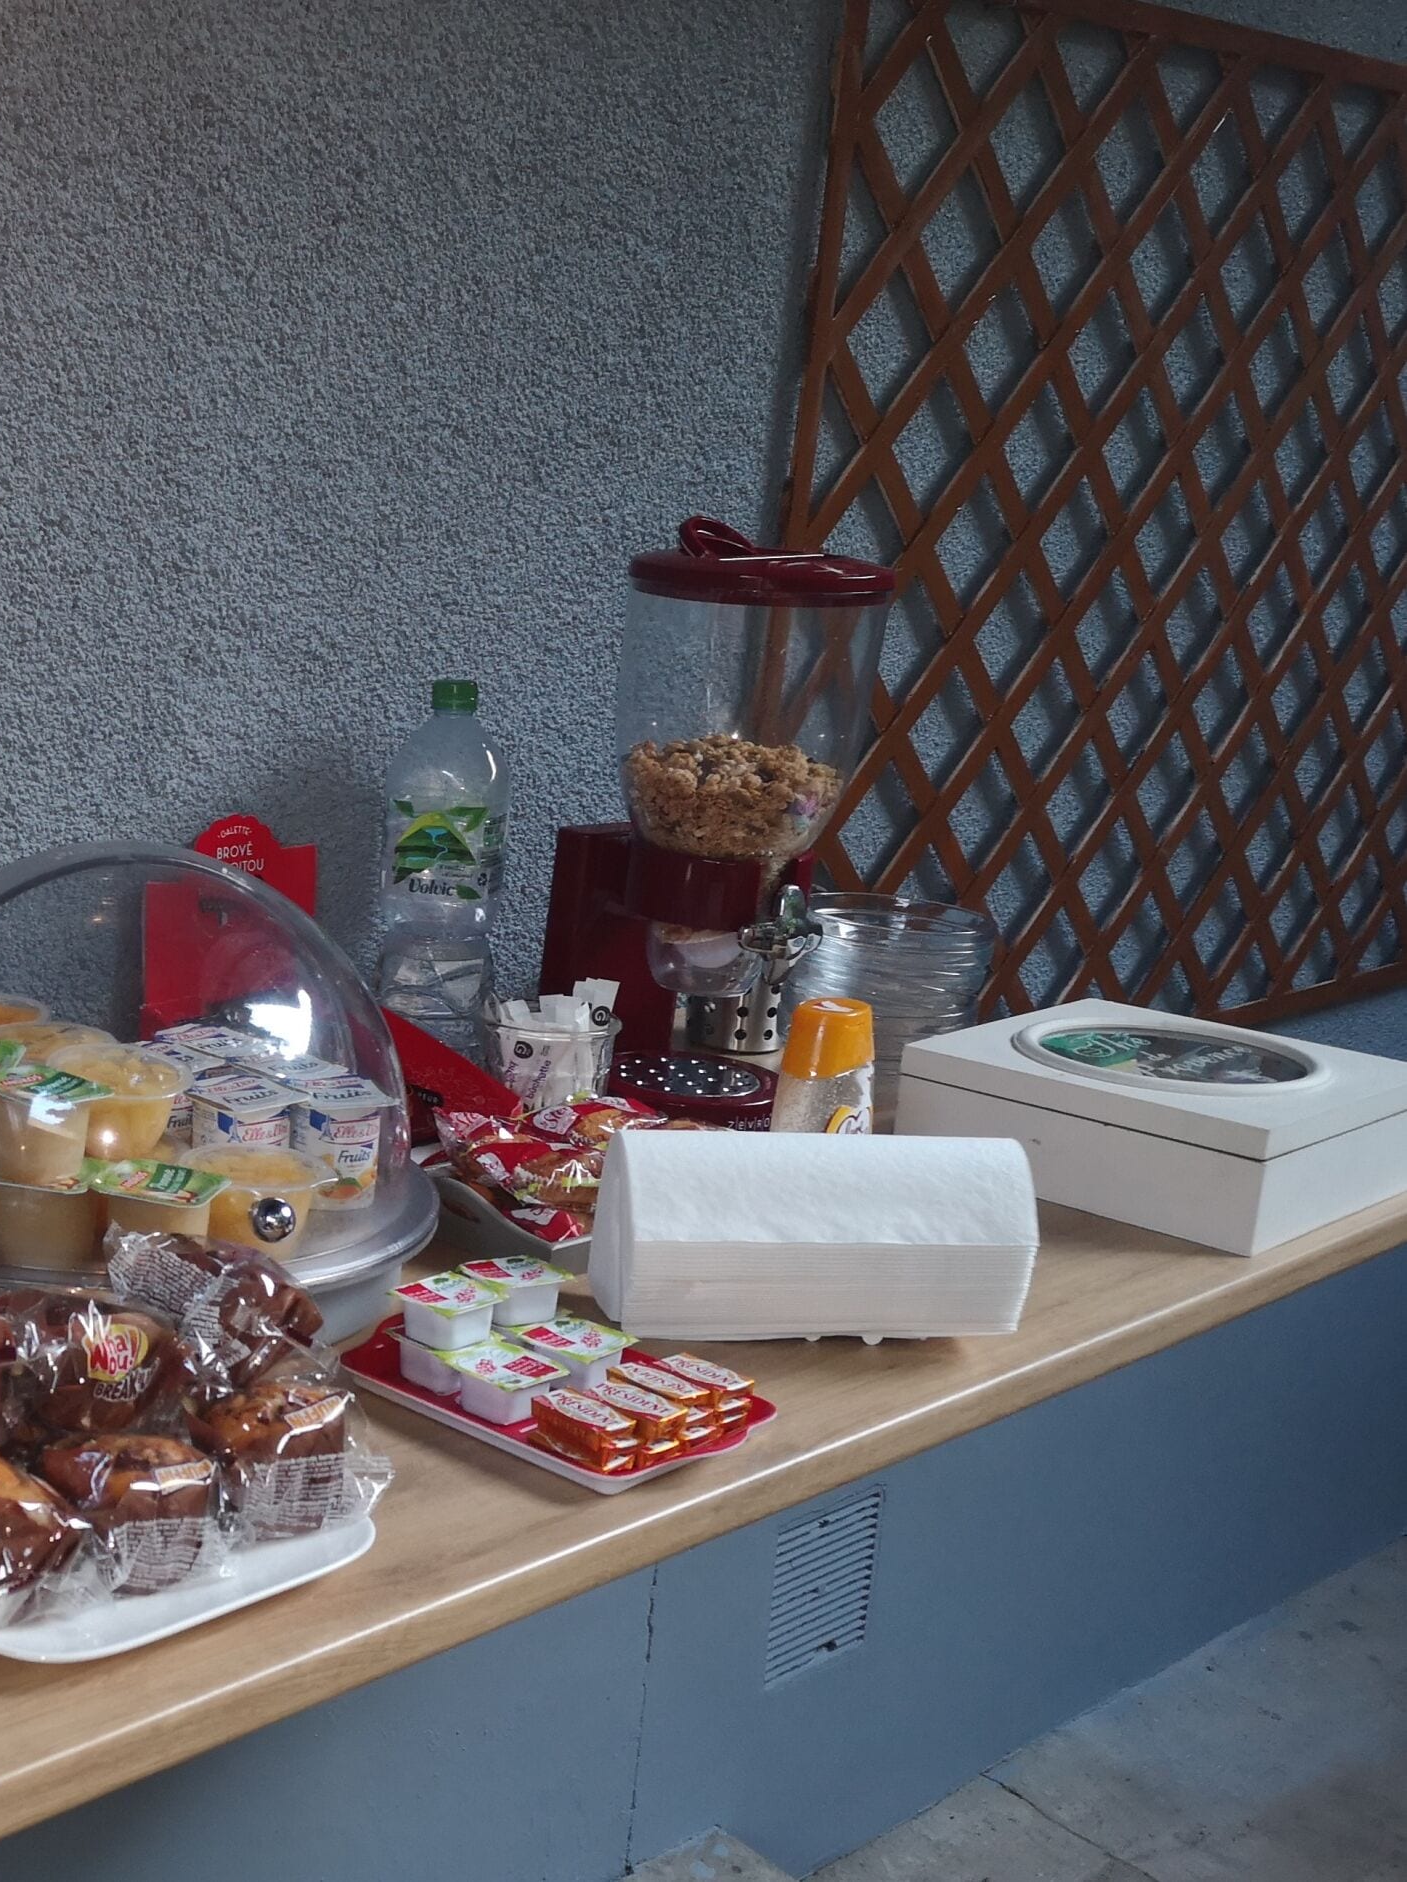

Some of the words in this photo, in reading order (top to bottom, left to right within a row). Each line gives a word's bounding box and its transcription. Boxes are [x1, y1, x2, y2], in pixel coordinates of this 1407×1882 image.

[409, 878, 456, 897] Volvic
[223, 1088, 279, 1104] Fruits
[312, 1088, 372, 1100] Fruits
[337, 1149, 371, 1164] Fruits
